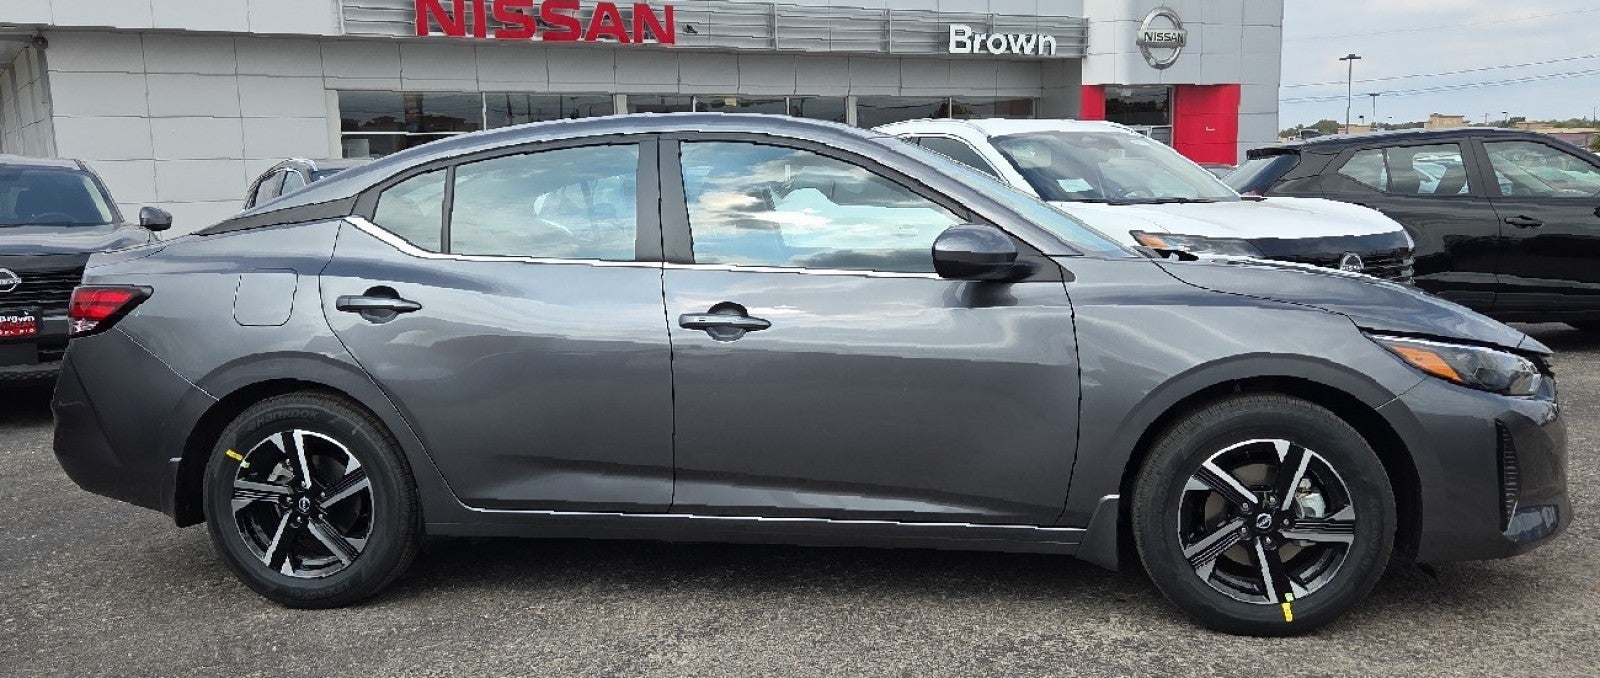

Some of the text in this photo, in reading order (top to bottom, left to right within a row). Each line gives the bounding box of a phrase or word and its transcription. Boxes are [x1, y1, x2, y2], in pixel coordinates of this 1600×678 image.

[415, 0, 676, 45] NISSAN
[1144, 31, 1185, 44] NISSAN
[949, 24, 1057, 56] Brown
